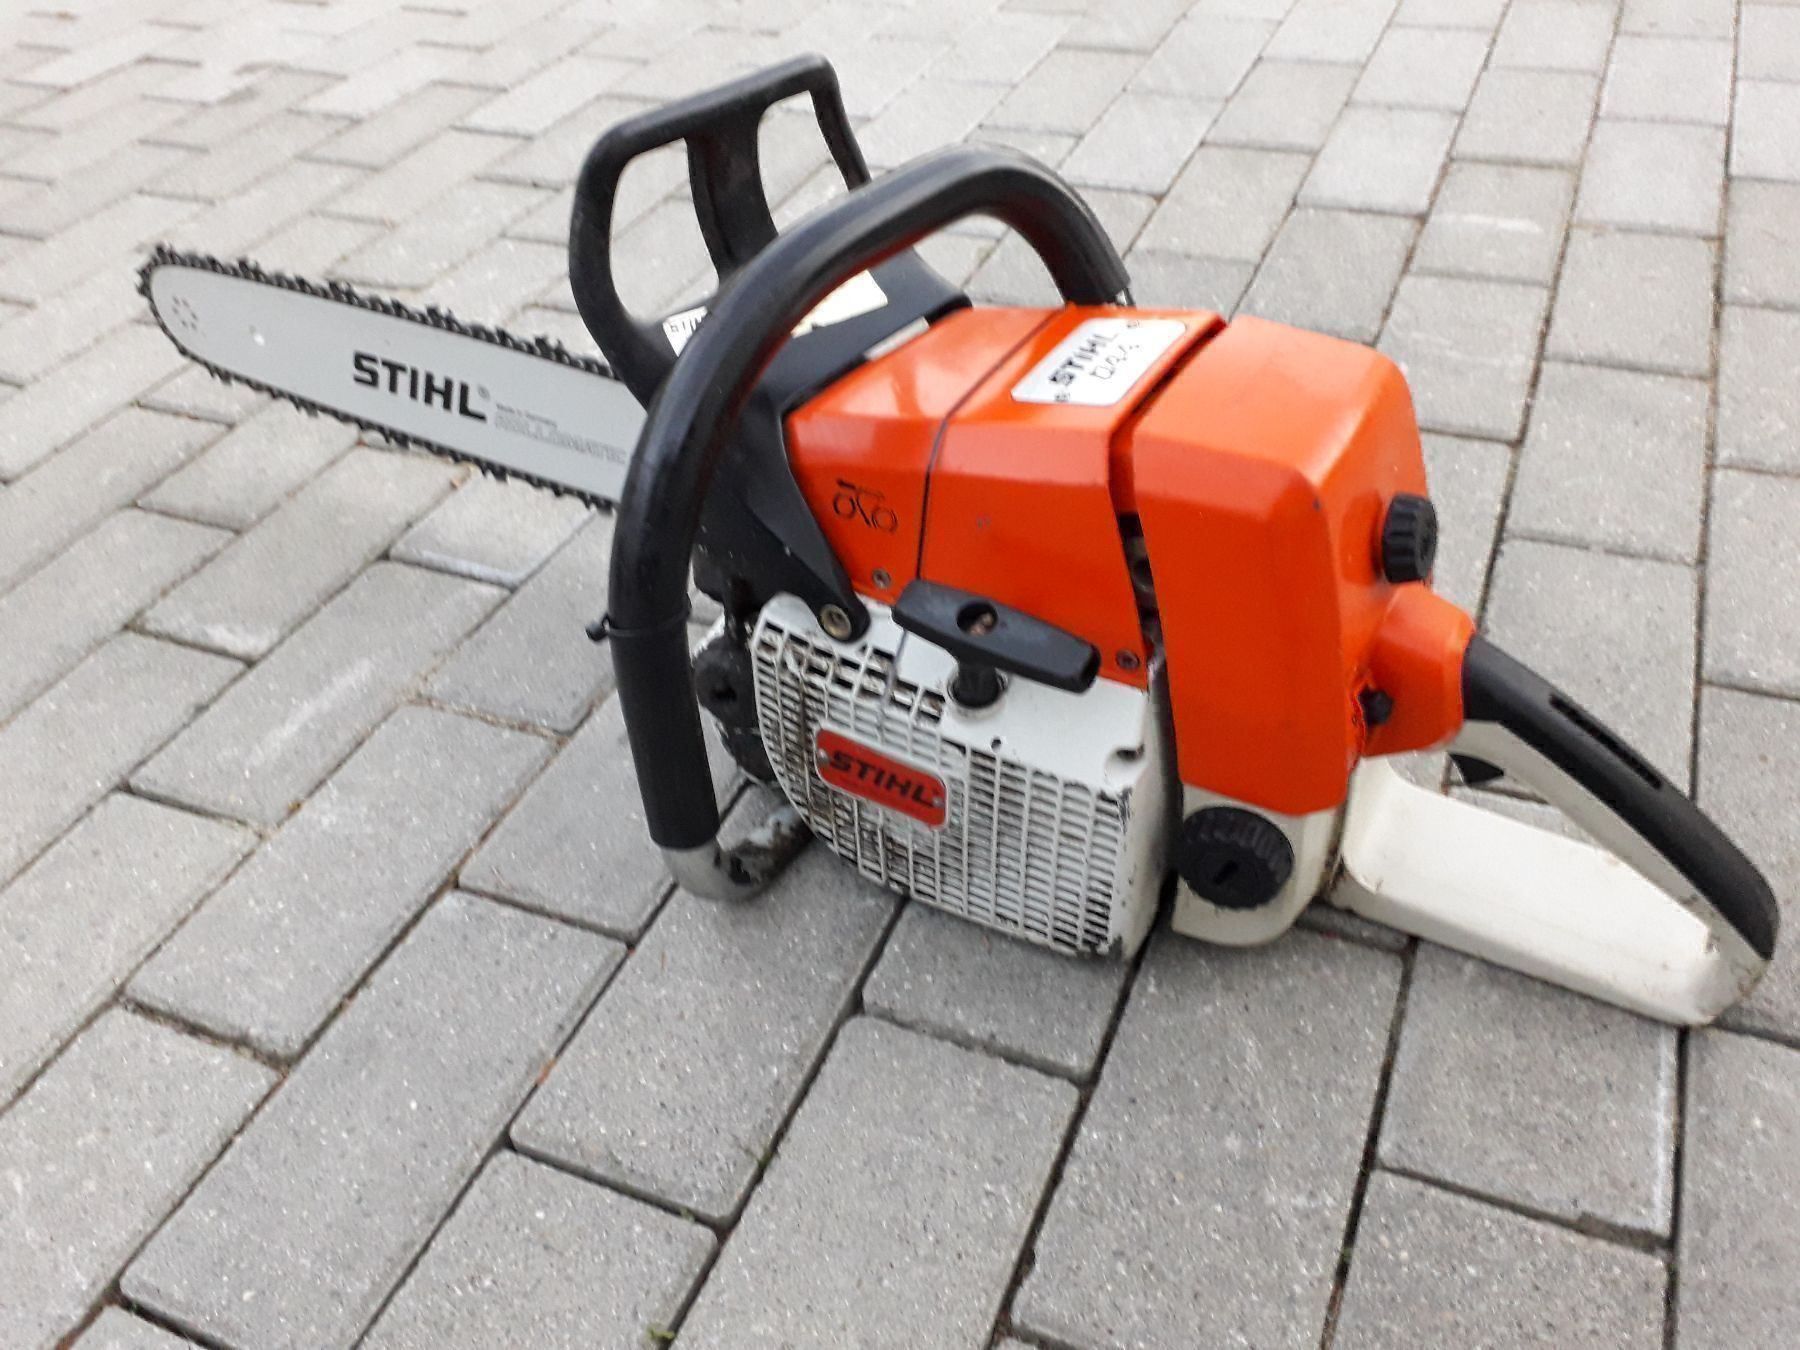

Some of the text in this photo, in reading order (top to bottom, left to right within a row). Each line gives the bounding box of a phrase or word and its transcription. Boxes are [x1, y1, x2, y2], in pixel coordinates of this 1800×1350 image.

[353, 350, 487, 423] STIHL
[1049, 333, 1118, 386] STIHL
[830, 750, 935, 809] STIHL
